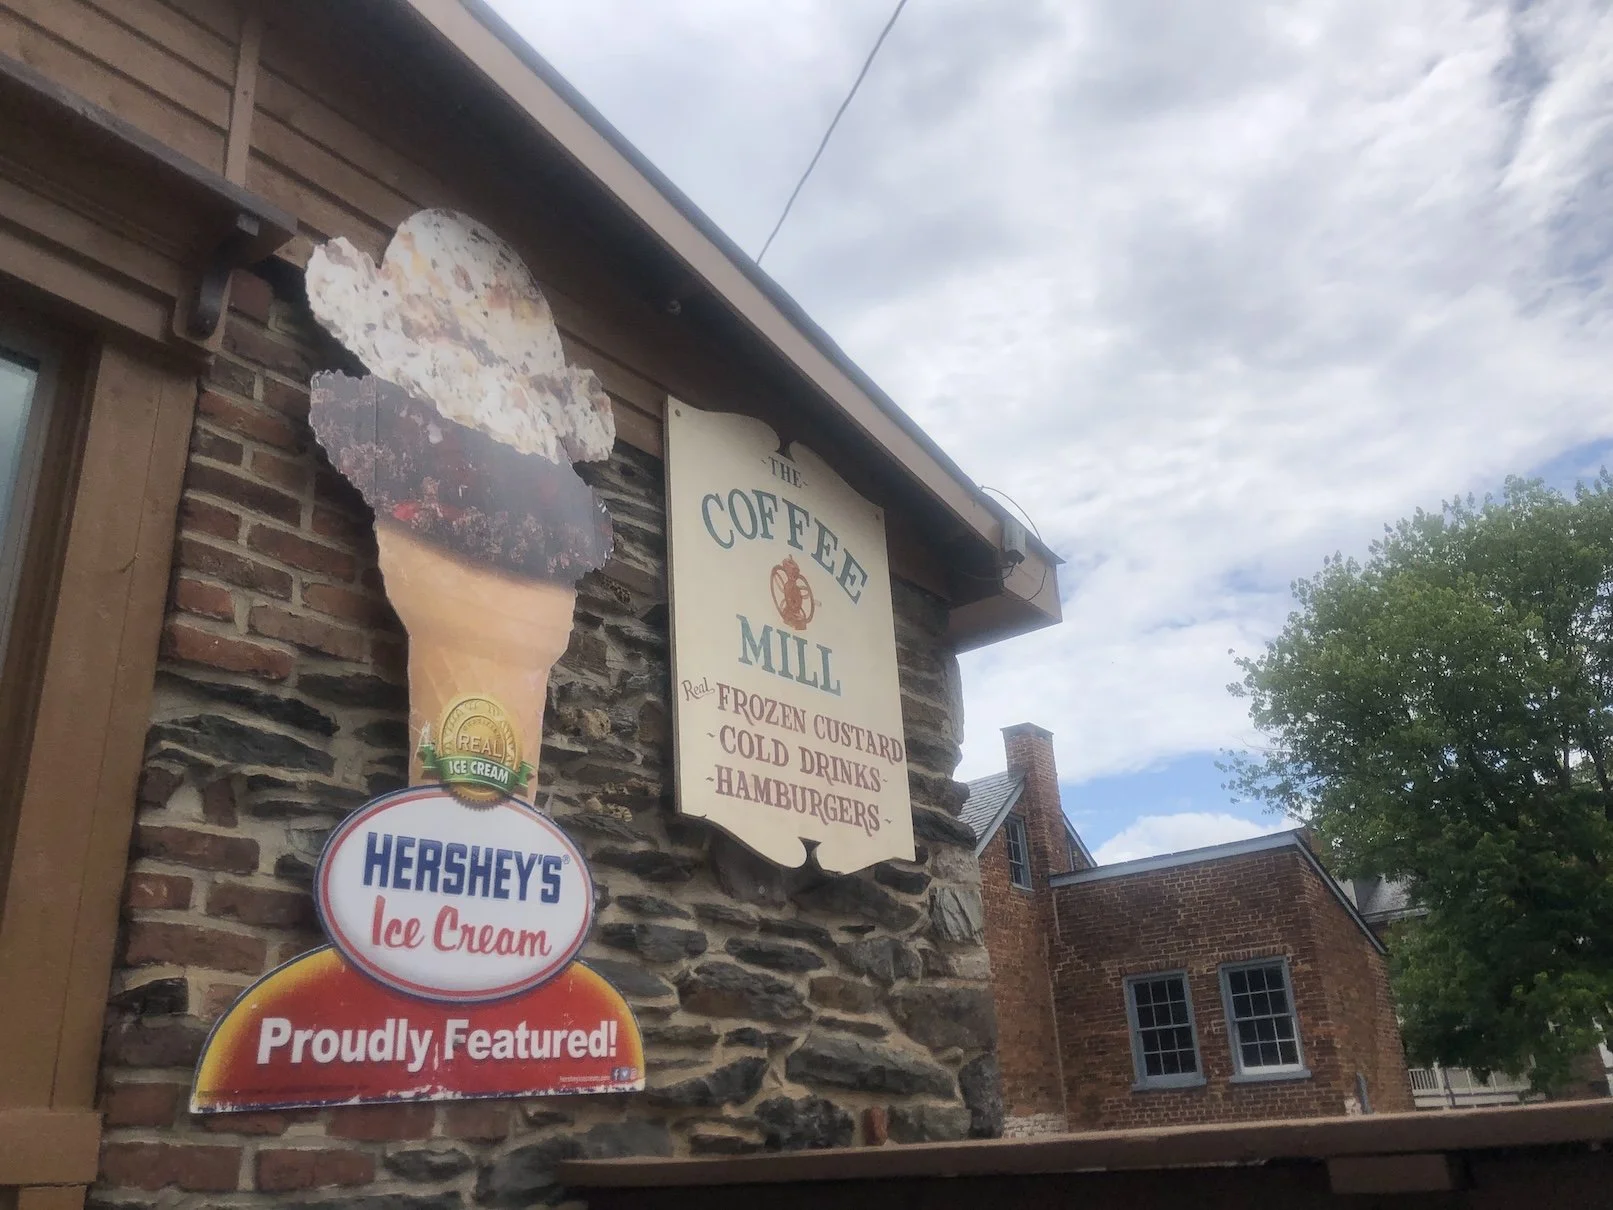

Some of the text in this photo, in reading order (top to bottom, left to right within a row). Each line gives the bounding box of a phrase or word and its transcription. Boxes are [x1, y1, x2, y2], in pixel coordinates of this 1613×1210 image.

[701, 488, 868, 604] COFFEE
[735, 613, 841, 697] MILL
[459, 735, 502, 757] REAL
[681, 677, 904, 765] Real FROZEN CUSTARD
[448, 760, 509, 784] ICE CREAM
[371, 895, 552, 957] Ice Cream
[256, 1017, 618, 1073] Proudly Featured!
